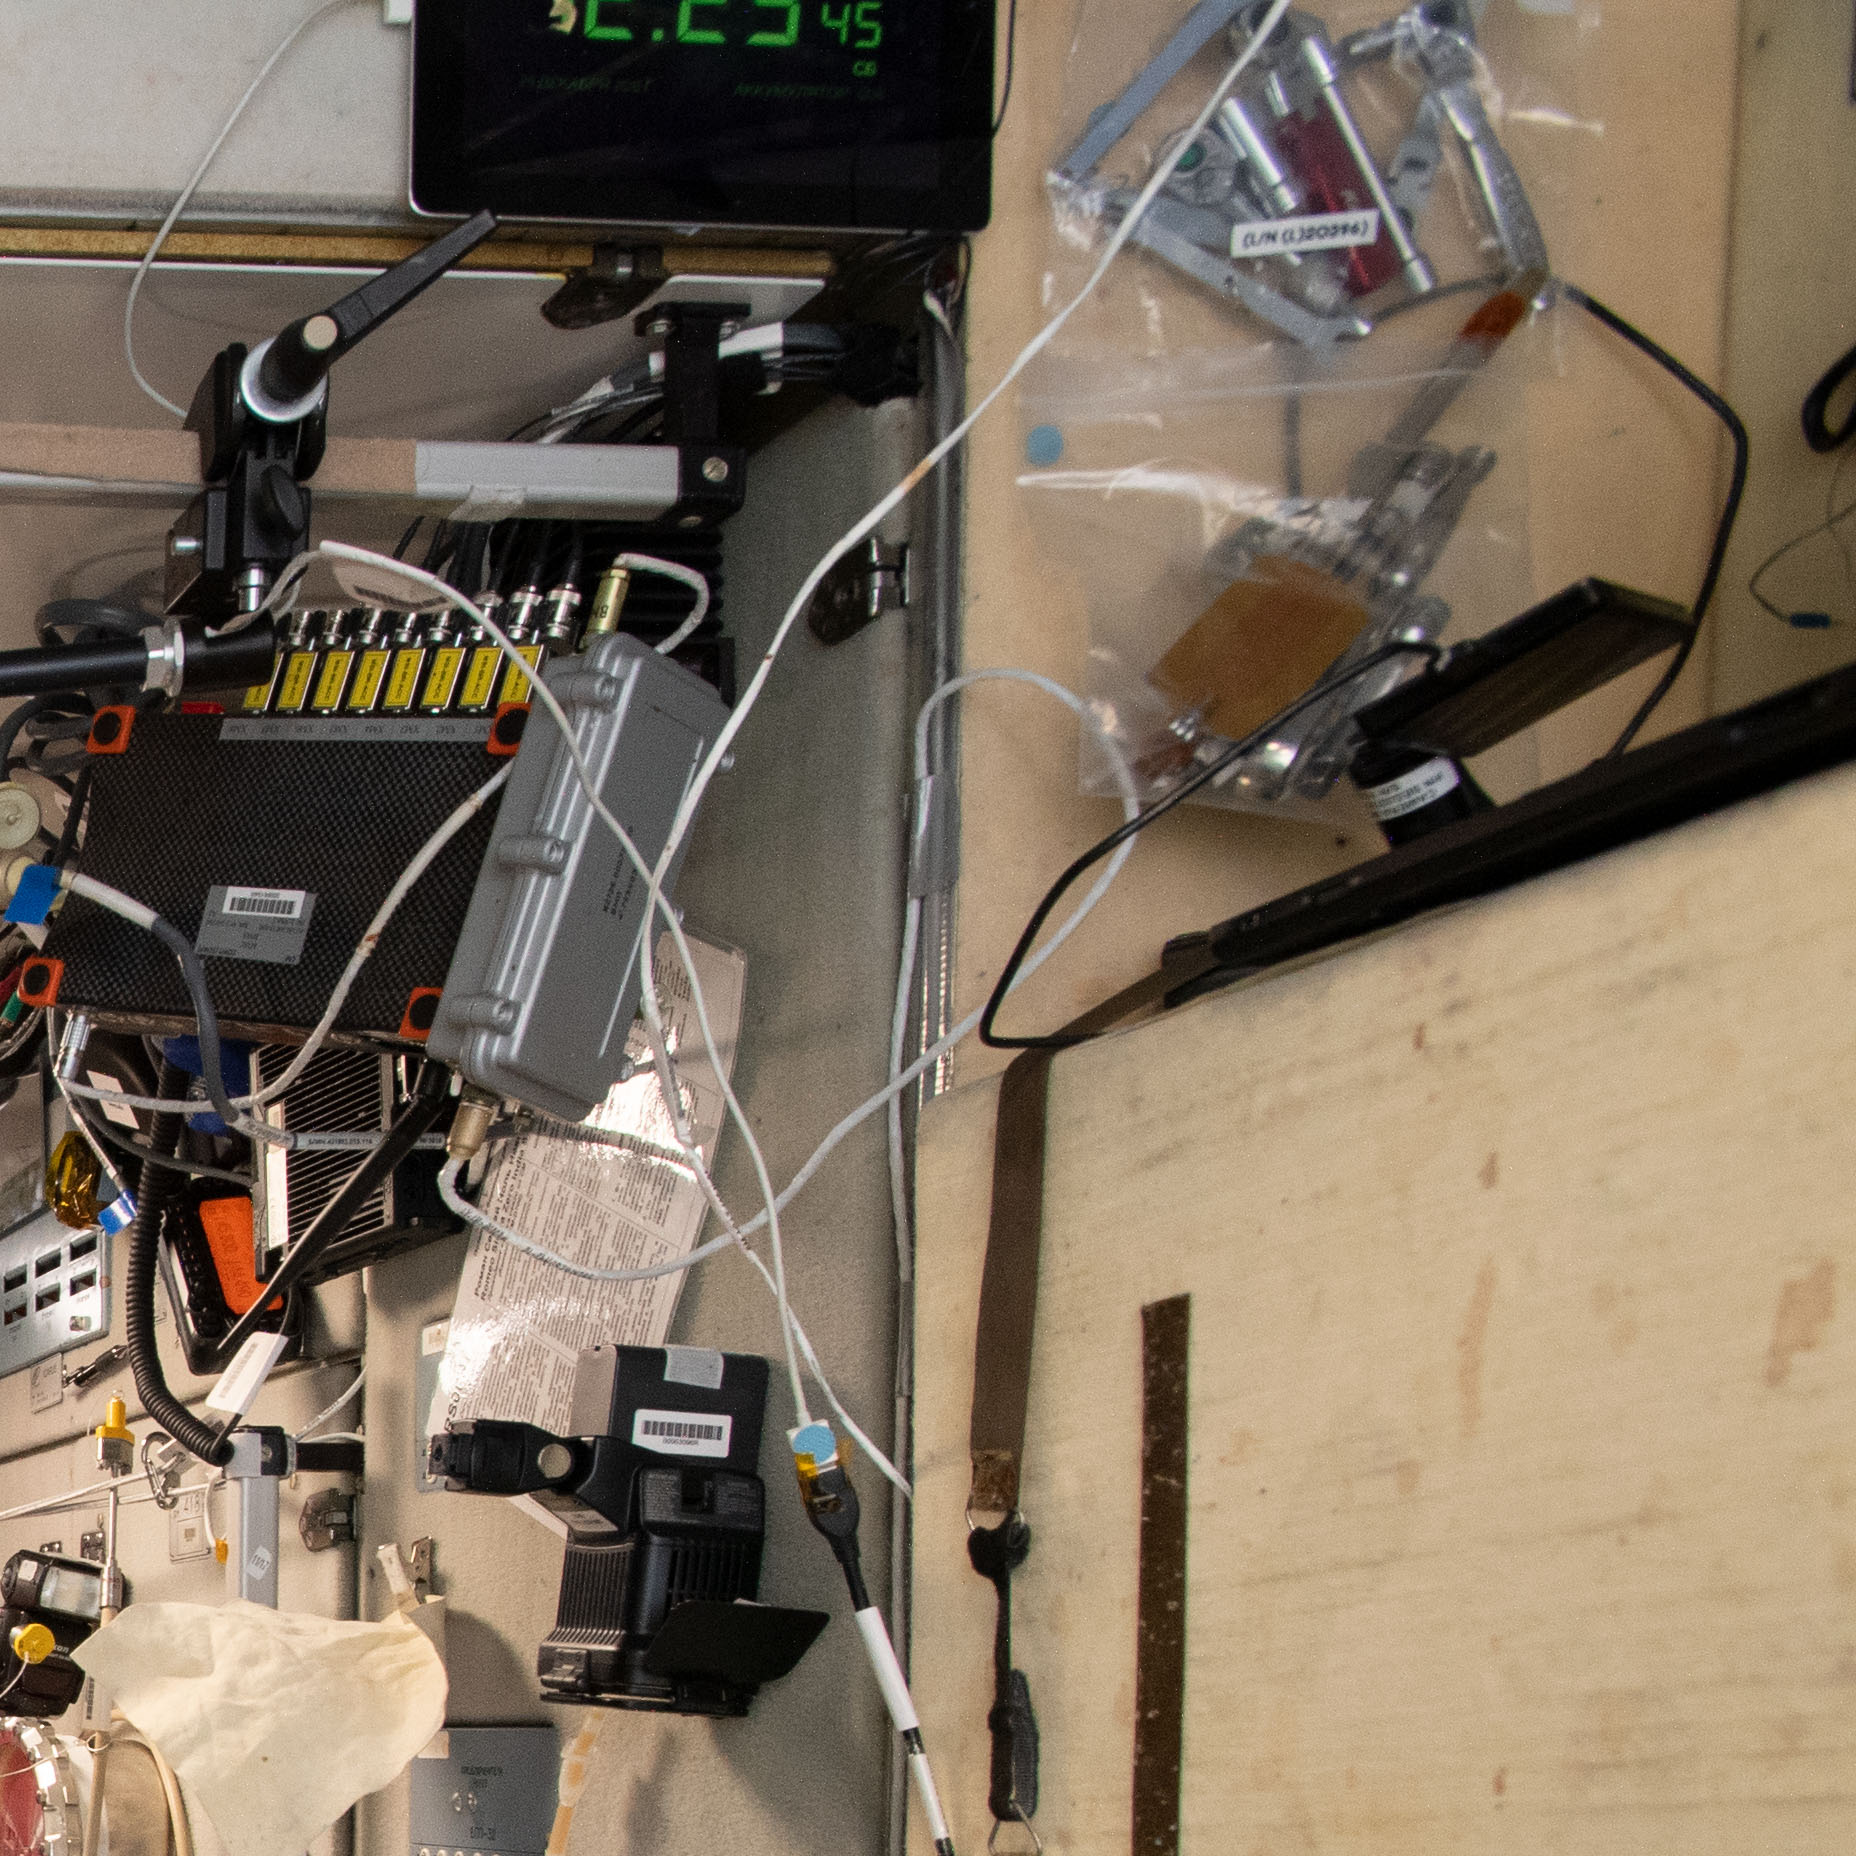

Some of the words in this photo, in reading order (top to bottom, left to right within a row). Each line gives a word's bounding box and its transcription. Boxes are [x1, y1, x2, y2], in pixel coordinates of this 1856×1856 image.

[822, 2, 882, 48] 45
[478, 1257, 498, 1300] Romeo
[501, 1183, 515, 1213] Zero
[510, 1149, 525, 1180] India
